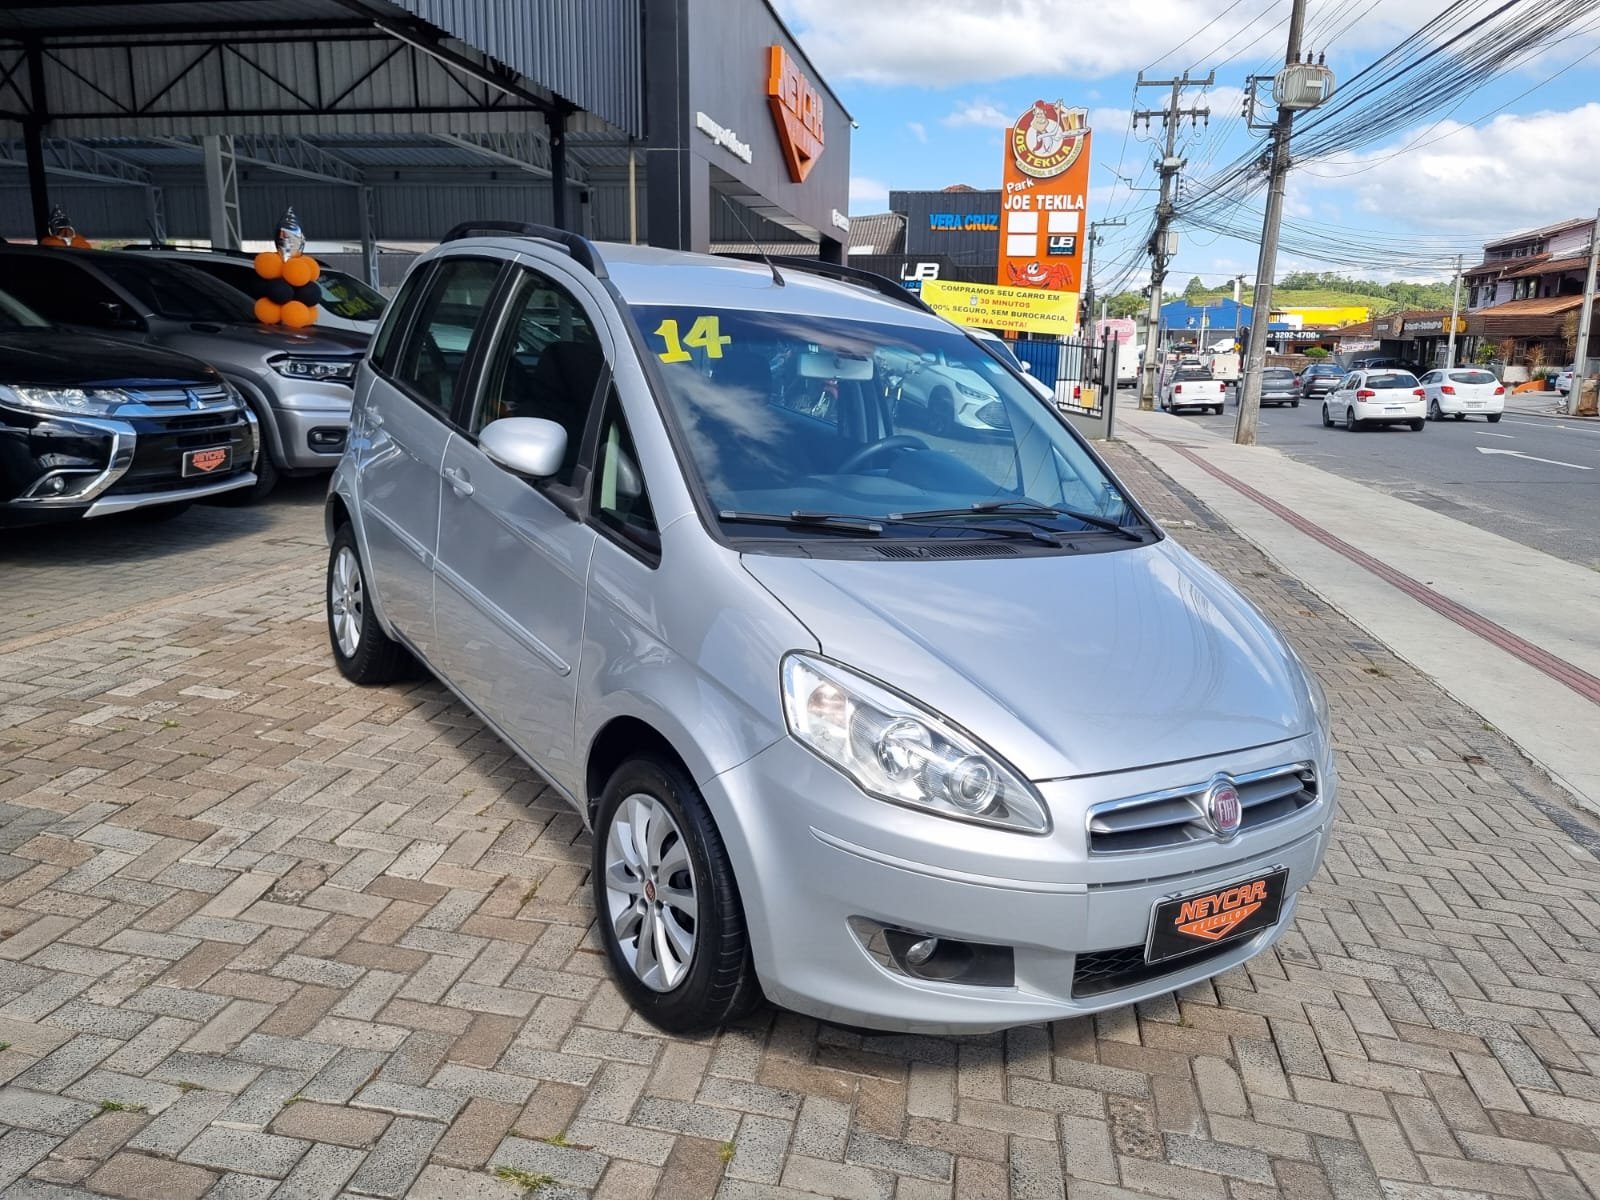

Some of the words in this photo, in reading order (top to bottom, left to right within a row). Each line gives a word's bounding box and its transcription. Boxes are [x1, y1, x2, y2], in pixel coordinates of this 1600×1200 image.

[1015, 127, 1026, 153] JOE
[1026, 145, 1071, 168] TEKILA
[1006, 177, 1035, 194] Park
[1004, 194, 1031, 210] JOE
[1036, 194, 1085, 210] TEKILA
[929, 213, 962, 231] VERA
[964, 213, 999, 231] CRUZ
[941, 284, 995, 296] COMPRAMOS
[997, 289, 1014, 297] SEU
[1016, 291, 1046, 300] CARRO
[1047, 294, 1061, 302] EM
[952, 306, 989, 316] SEGURO,
[992, 299, 1031, 309] MINUTOS
[966, 316, 980, 324] PIX
[996, 319, 1028, 328] CONTA!
[653, 315, 732, 364] 14
[1275, 331, 1316, 339] 3202-4700
[1218, 798, 1236, 823] FIAT
[1174, 880, 1268, 925] NEYCAR
[1191, 909, 1249, 932] VEICULOS
